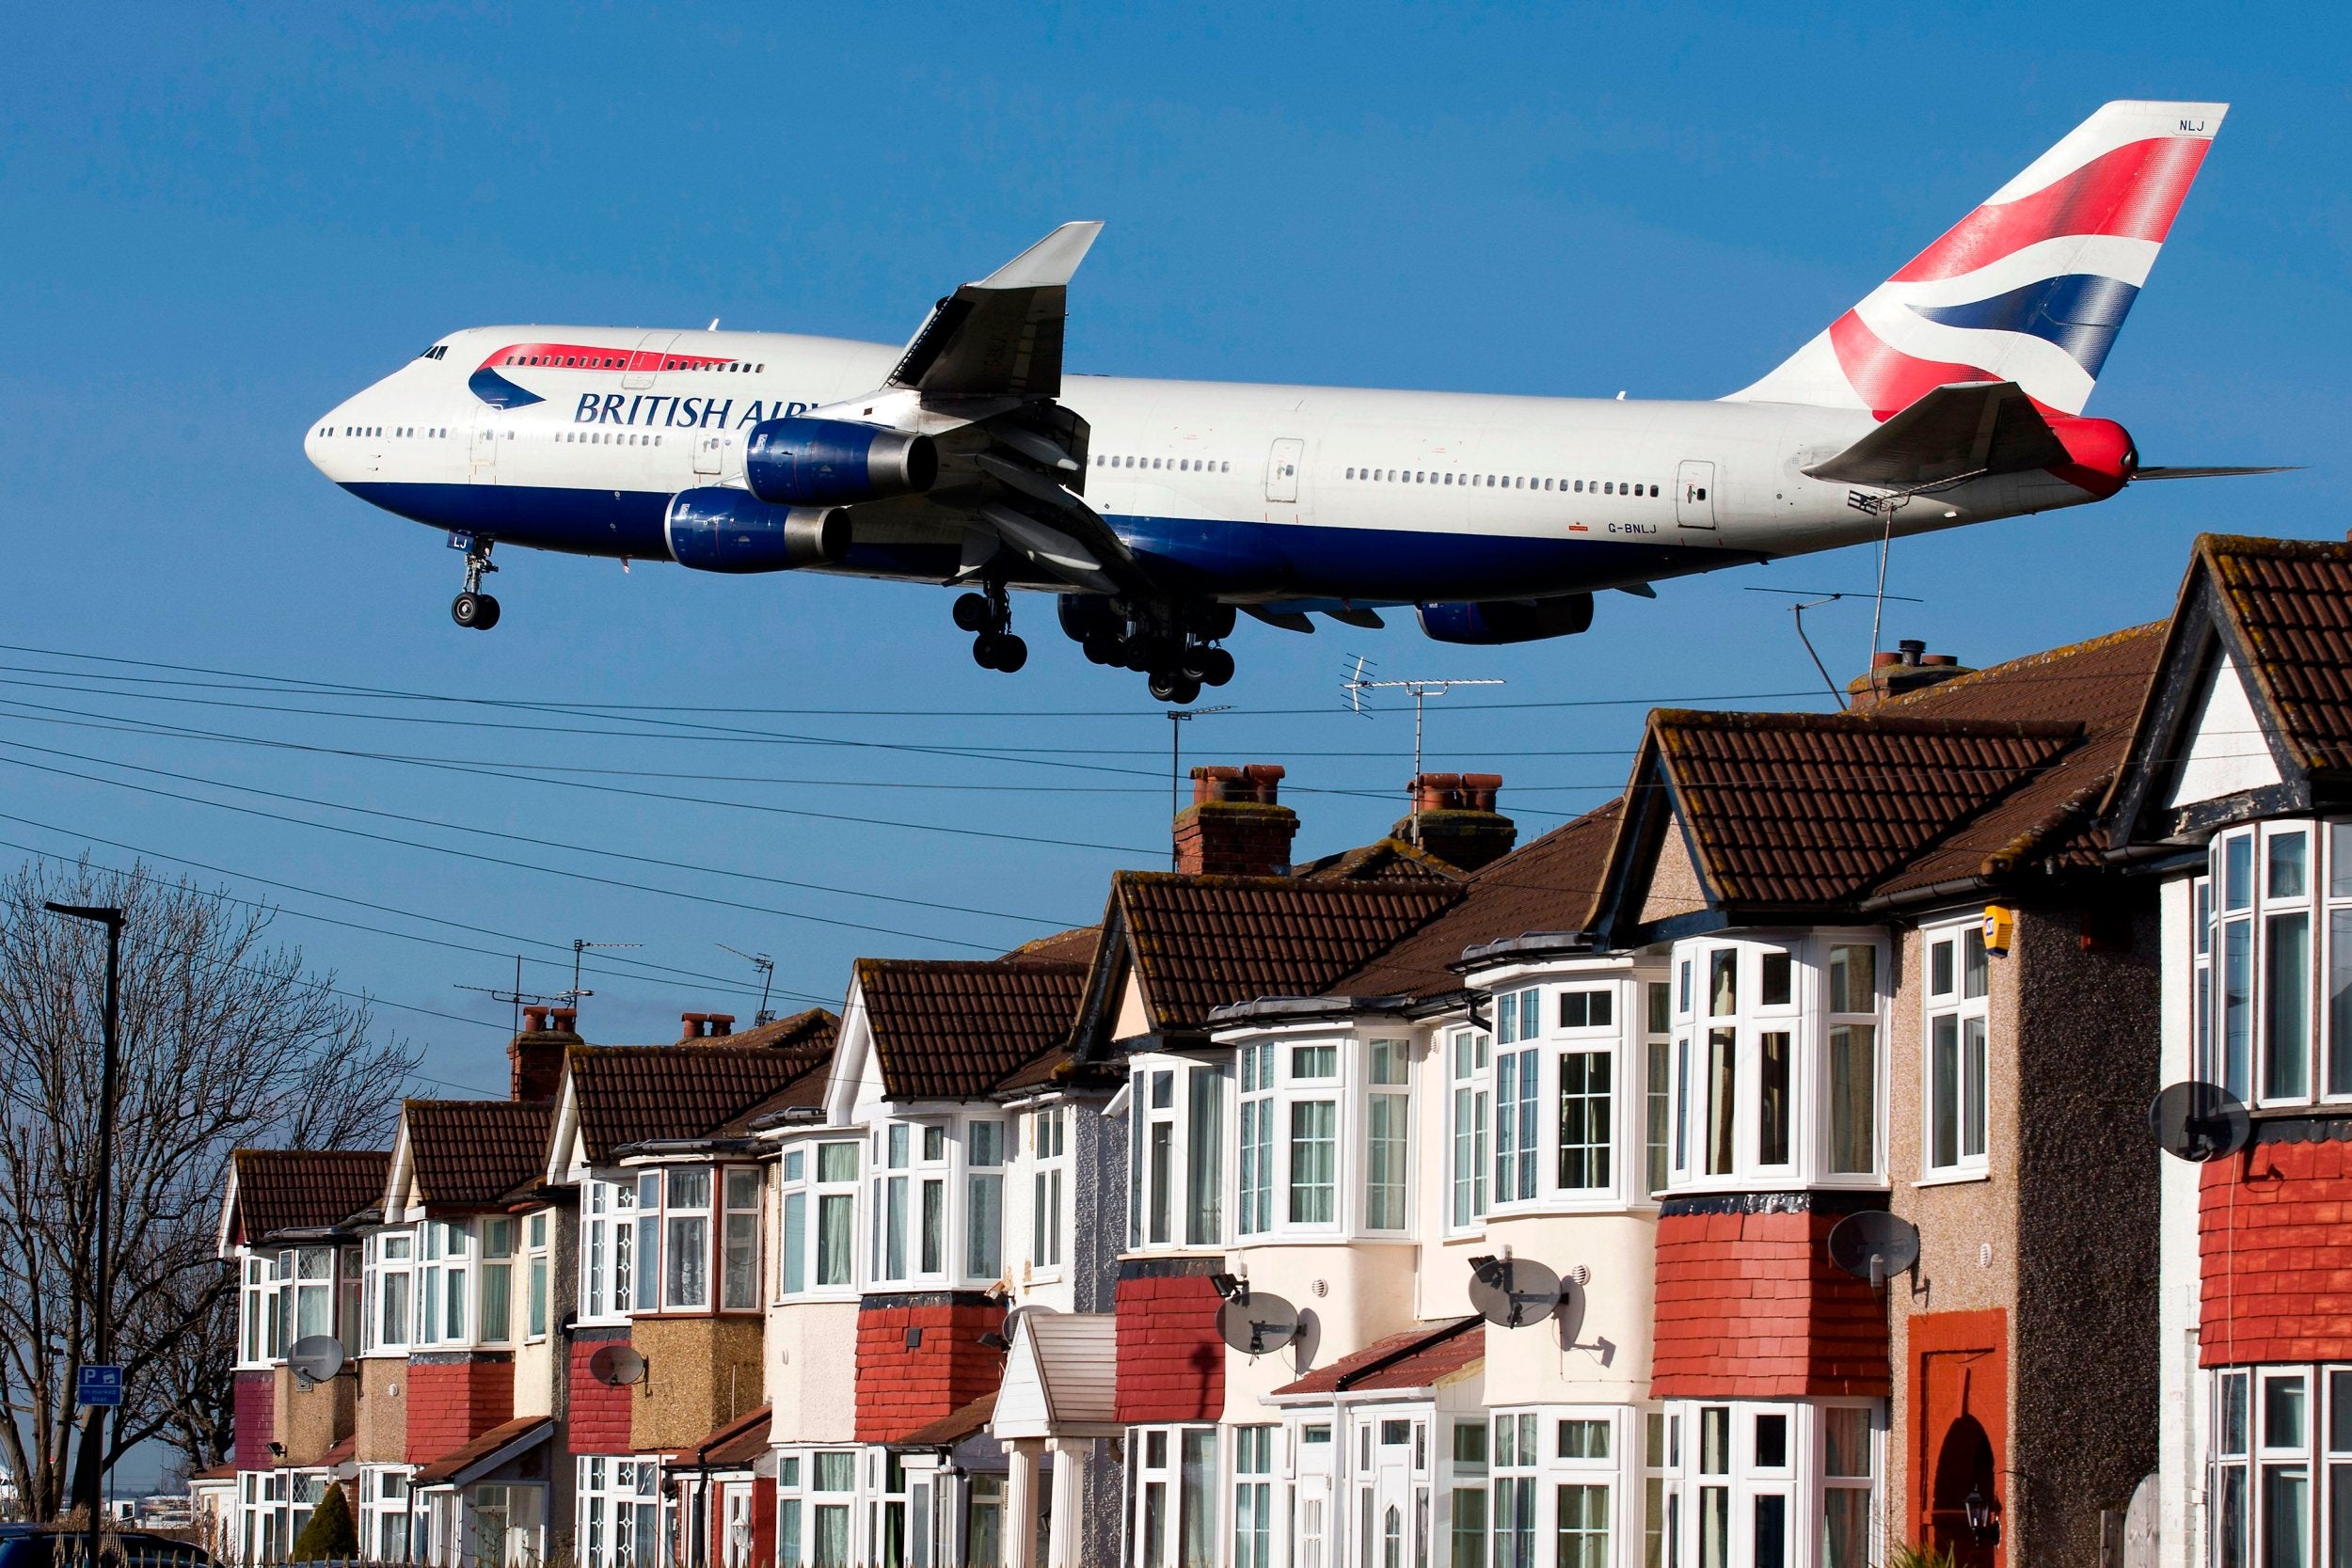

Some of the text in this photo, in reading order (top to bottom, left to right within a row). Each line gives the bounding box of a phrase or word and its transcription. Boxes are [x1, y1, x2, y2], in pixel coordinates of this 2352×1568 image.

[2179, 119, 2204, 132] NLJ
[574, 392, 734, 429] BRITISH
[1608, 523, 1657, 534] G-BNLJ
[453, 536, 468, 549] LJ
[85, 1369, 96, 1384] P
